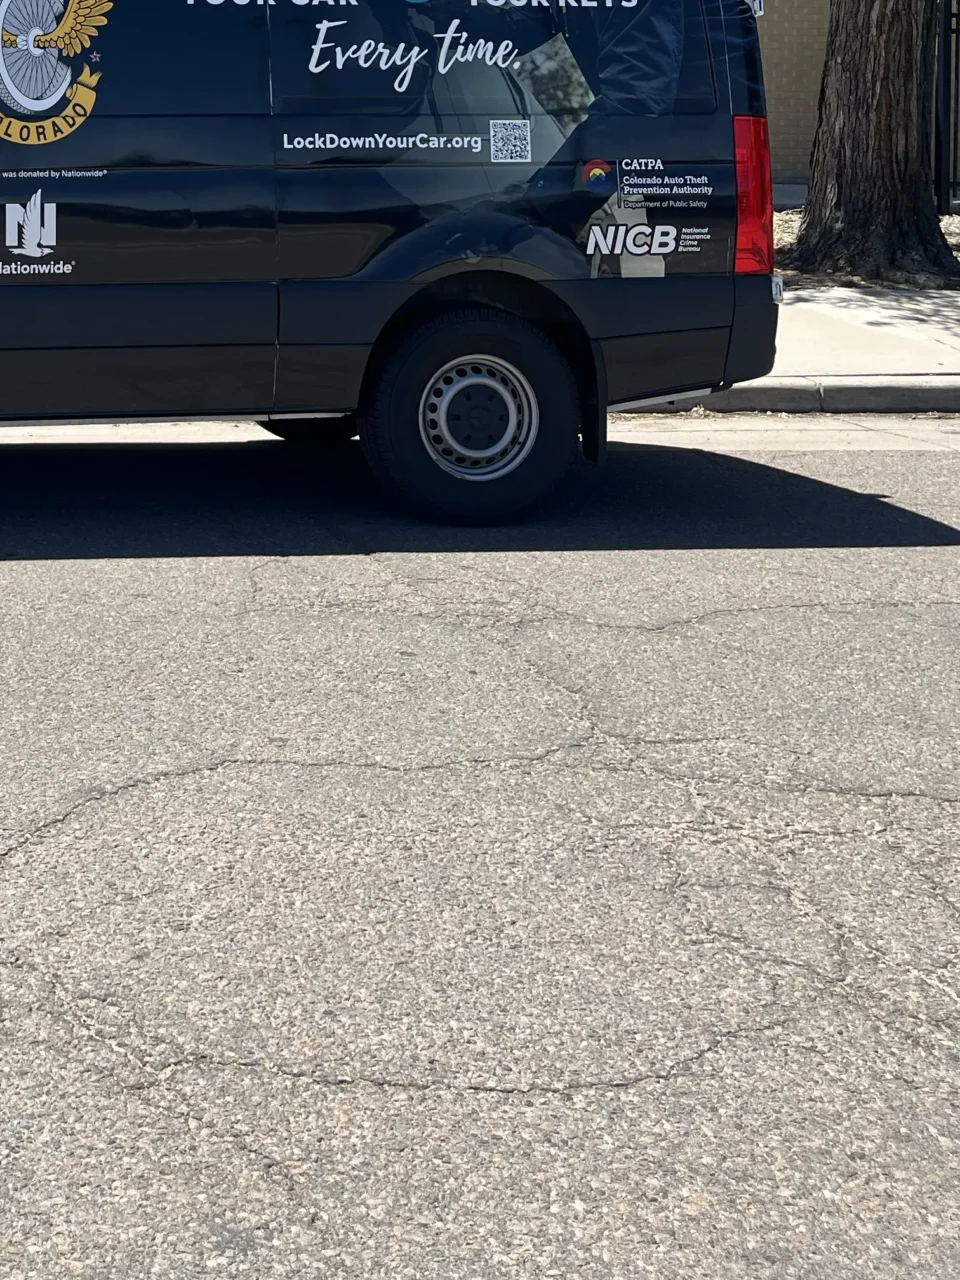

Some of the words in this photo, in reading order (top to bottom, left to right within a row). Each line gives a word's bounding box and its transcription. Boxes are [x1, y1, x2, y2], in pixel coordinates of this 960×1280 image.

[307, 19, 428, 93] Every
[434, 18, 521, 75] time.
[283, 132, 482, 153] LockDownYourCar.org
[622, 159, 664, 170] CATPA
[50, 170, 60, 179] by
[623, 176, 662, 184] Colorado
[664, 176, 683, 184] Auto
[685, 175, 708, 184] Theft
[624, 186, 671, 194] Prevention
[672, 185, 713, 195] Authority
[624, 200, 661, 209] Department
[662, 200, 669, 208] of
[669, 200, 688, 208] Public
[689, 200, 707, 208] Safety
[586, 225, 676, 255] NICB
